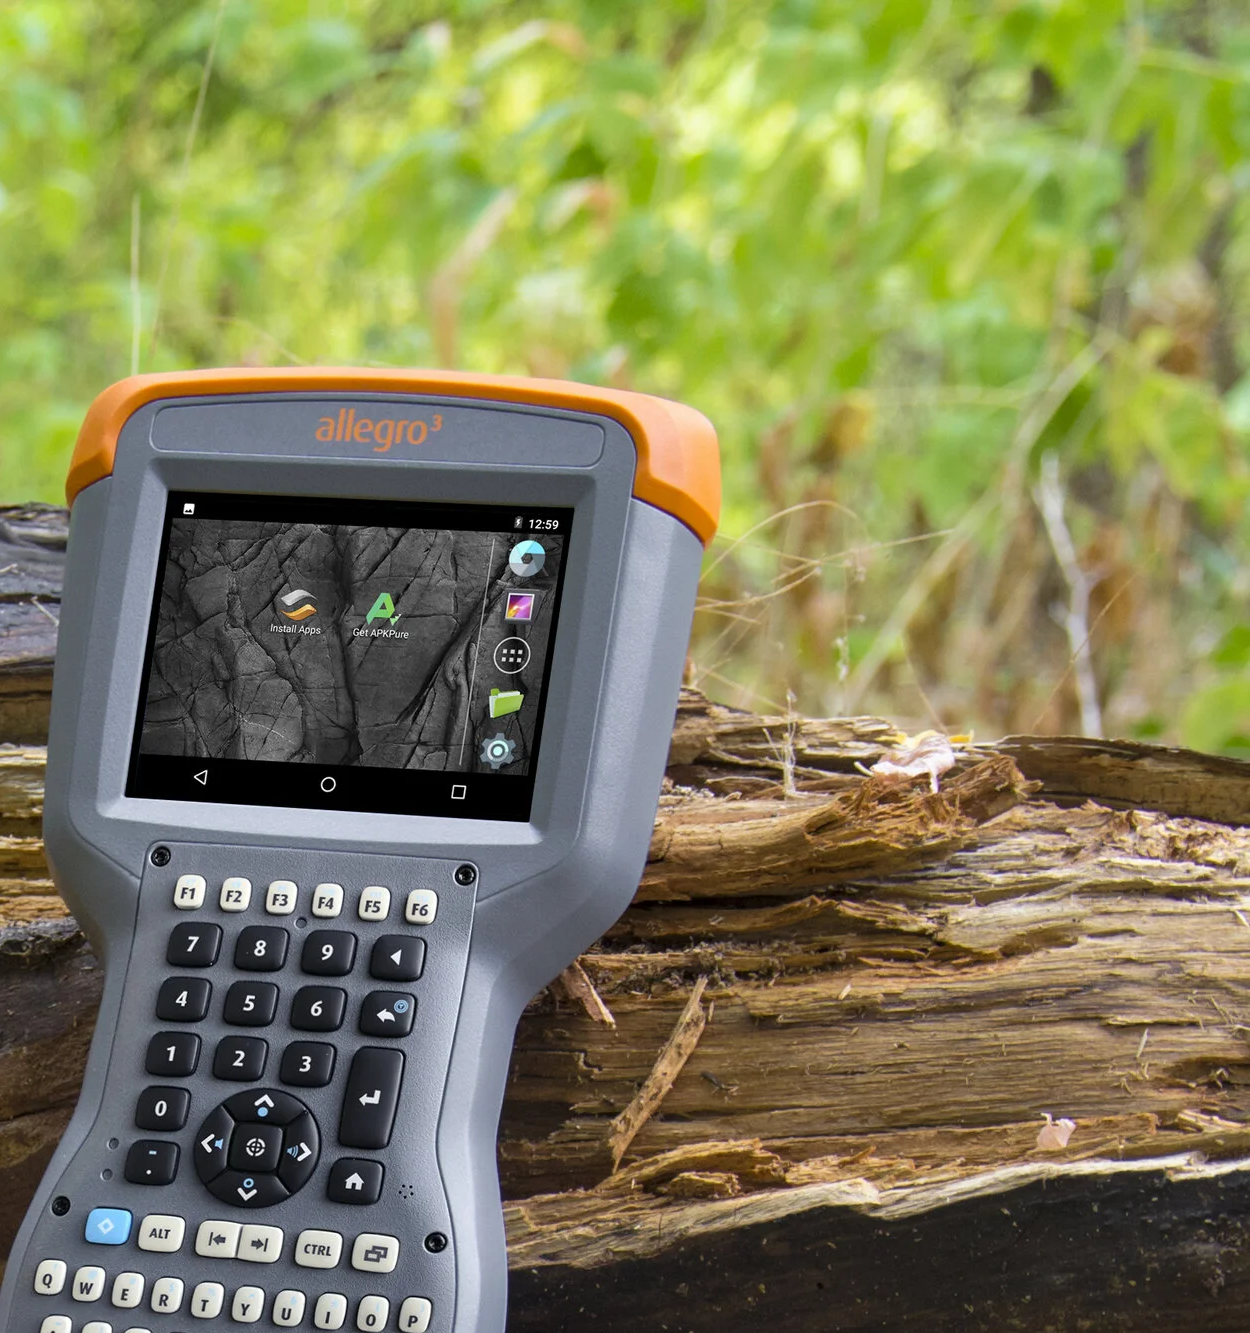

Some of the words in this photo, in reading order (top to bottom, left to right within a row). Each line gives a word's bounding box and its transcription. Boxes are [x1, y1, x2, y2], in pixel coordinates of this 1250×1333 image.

[528, 518, 559, 530] 12:59
[269, 623, 297, 634] Install
[297, 625, 322, 636] Apps
[352, 627, 369, 637] Get
[370, 629, 410, 640] APKPure
[180, 887, 196, 900] F1
[225, 890, 243, 903] F2
[271, 893, 289, 907] F3
[317, 896, 334, 910] F4
[364, 900, 381, 914] F5
[411, 903, 429, 917] F6
[187, 936, 200, 952] 7
[253, 939, 267, 957] 8
[321, 944, 334, 961] 9
[175, 990, 188, 1007] 4
[242, 994, 256, 1012] 5
[310, 1000, 323, 1017] 6
[166, 1045, 176, 1062] 1
[232, 1050, 245, 1067] 2
[299, 1055, 312, 1072] 3
[154, 1100, 167, 1117] 0
[148, 1227, 171, 1240] ALT
[303, 1243, 332, 1257] CTRL
[42, 1273, 53, 1289] Q
[79, 1281, 94, 1296] W
[120, 1288, 129, 1302] E
[158, 1293, 169, 1307] R
[200, 1299, 209, 1312] T
[241, 1303, 250, 1317] Y
[281, 1307, 292, 1321] U
[324, 1311, 331, 1324] I
[365, 1313, 377, 1327] O
[407, 1315, 419, 1328] P
